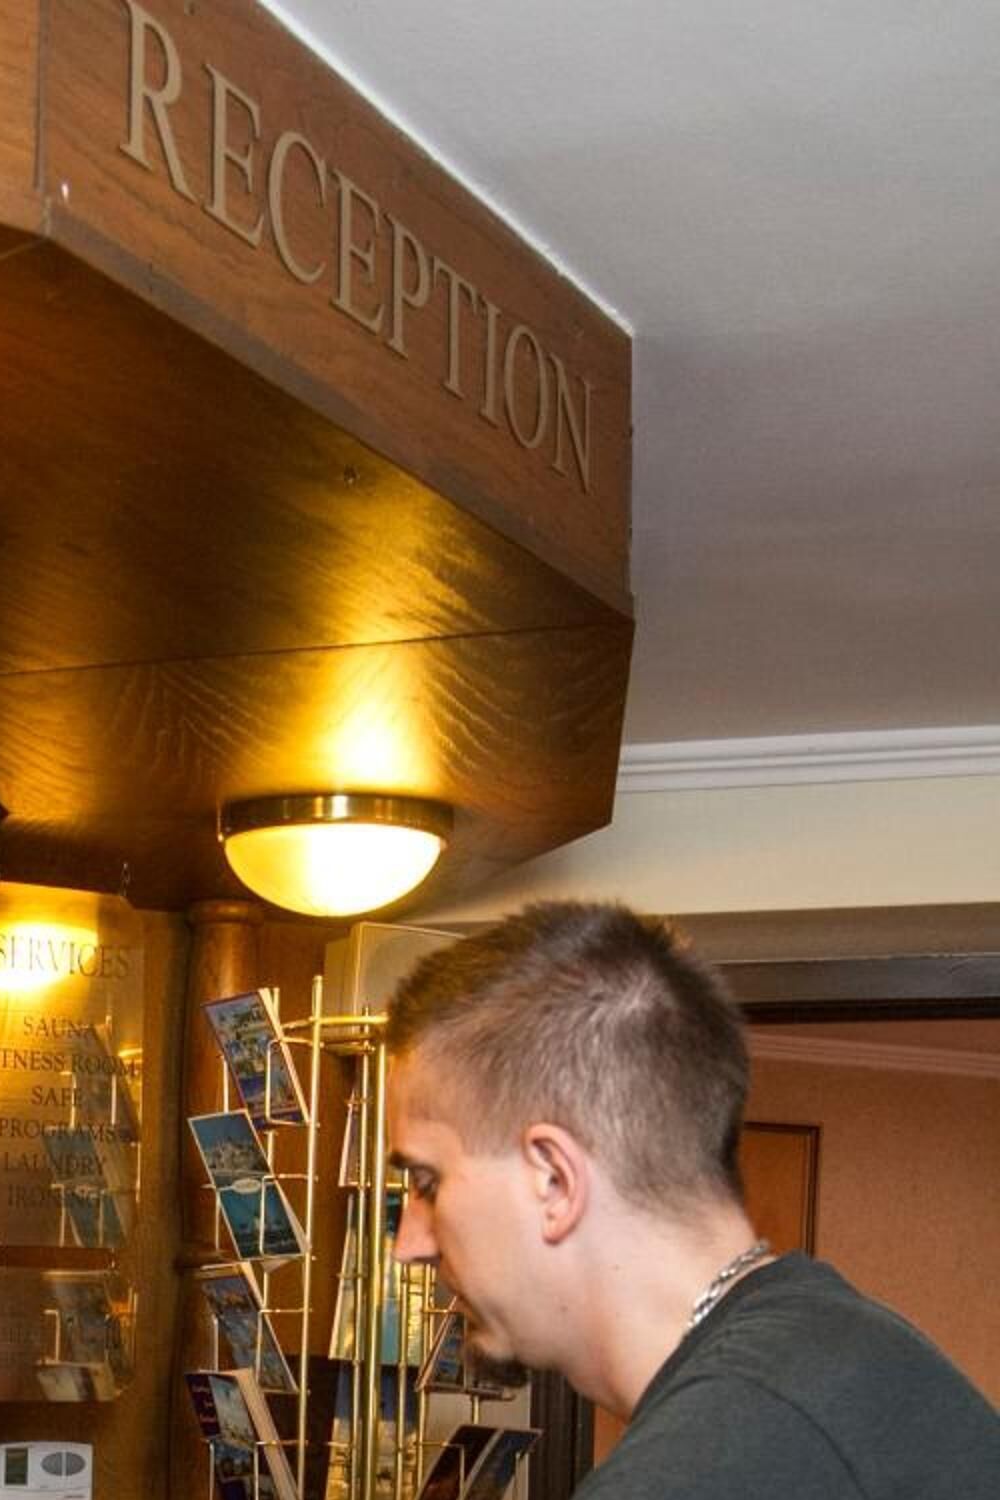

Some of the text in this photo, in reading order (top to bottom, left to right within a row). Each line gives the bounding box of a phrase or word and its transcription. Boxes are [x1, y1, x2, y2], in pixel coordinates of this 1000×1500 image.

[119, 0, 597, 496] RECEPTION
[22, 1015, 101, 1041] SAUNA
[71, 1054, 139, 1078] ROOM
[31, 1085, 83, 1110] SAFE
